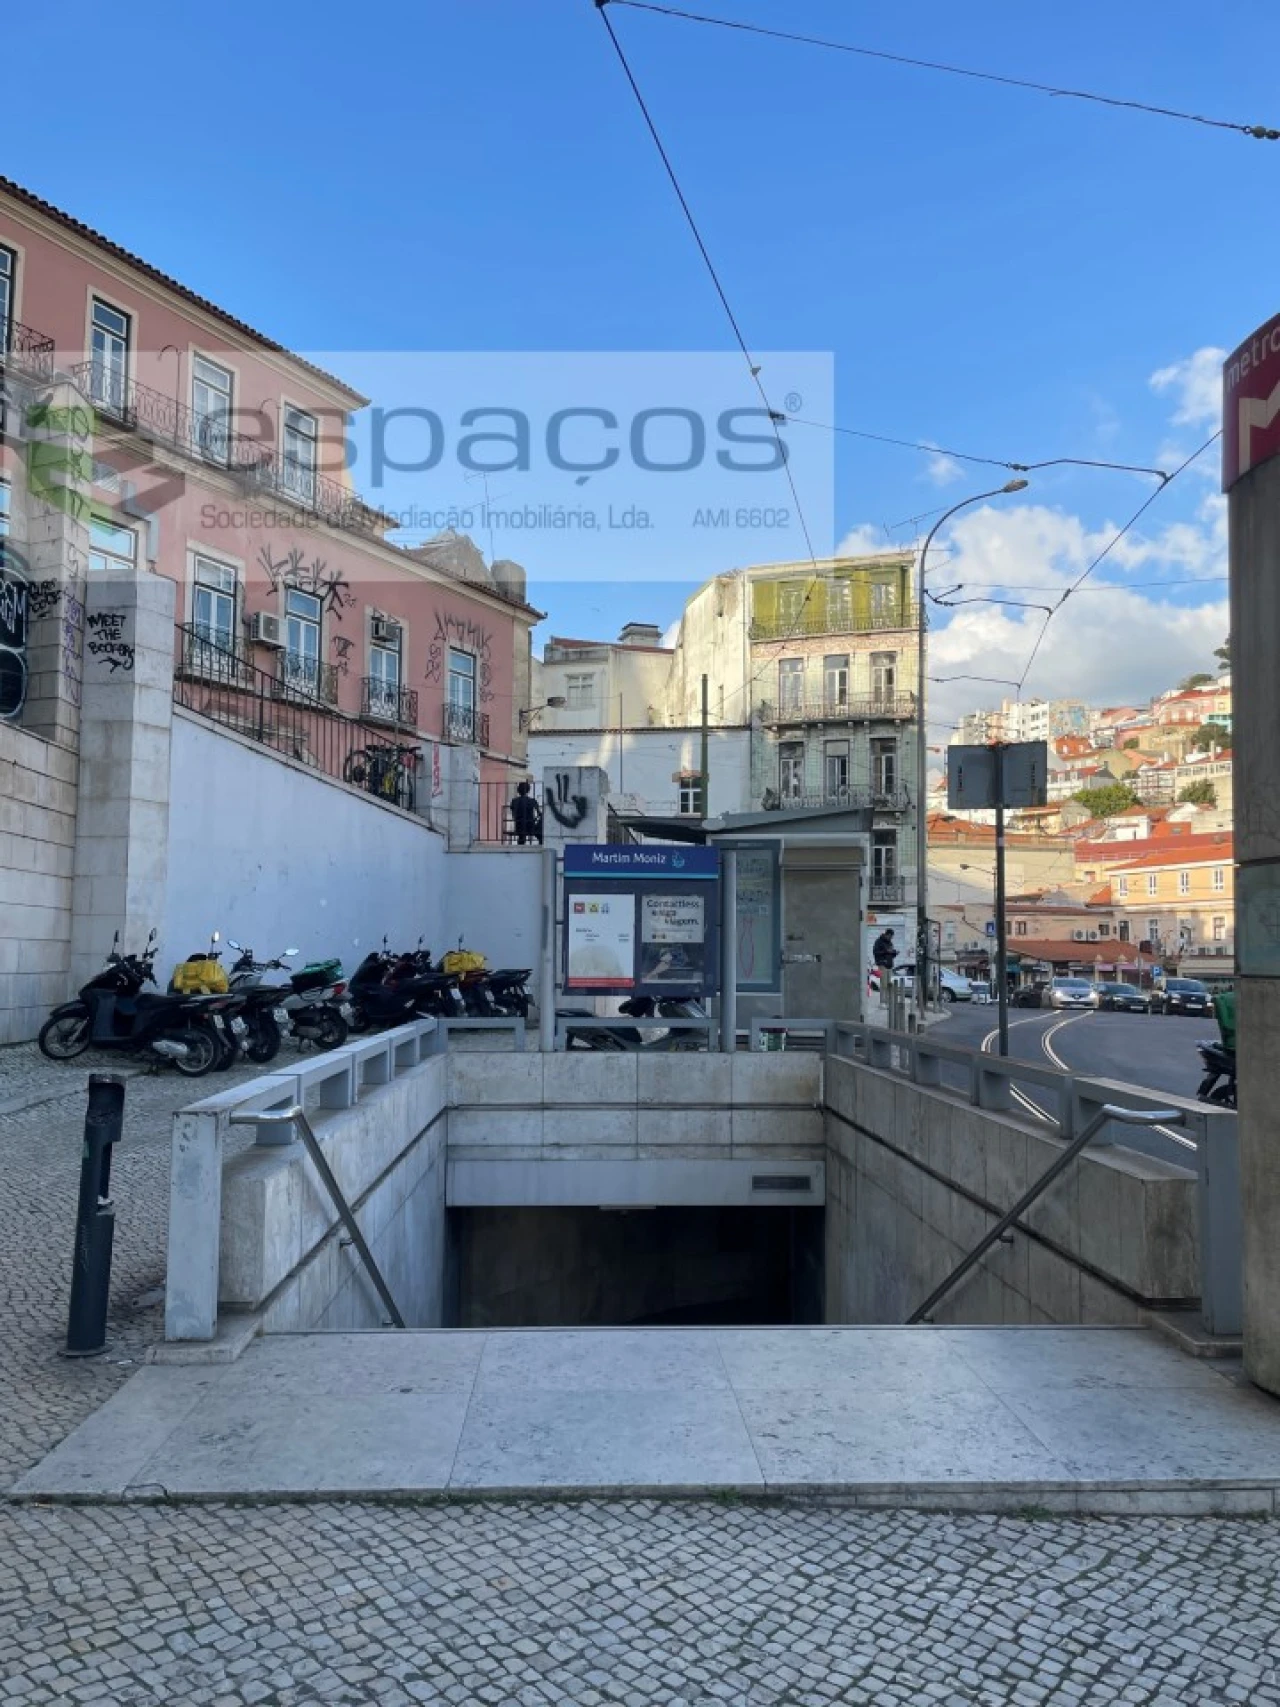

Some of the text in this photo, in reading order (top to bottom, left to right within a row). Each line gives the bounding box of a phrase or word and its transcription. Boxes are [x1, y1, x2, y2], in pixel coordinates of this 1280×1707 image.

[87, 612, 126, 629] MEET
[93, 628, 122, 641] THE
[592, 852, 667, 865] Martim Moniz
